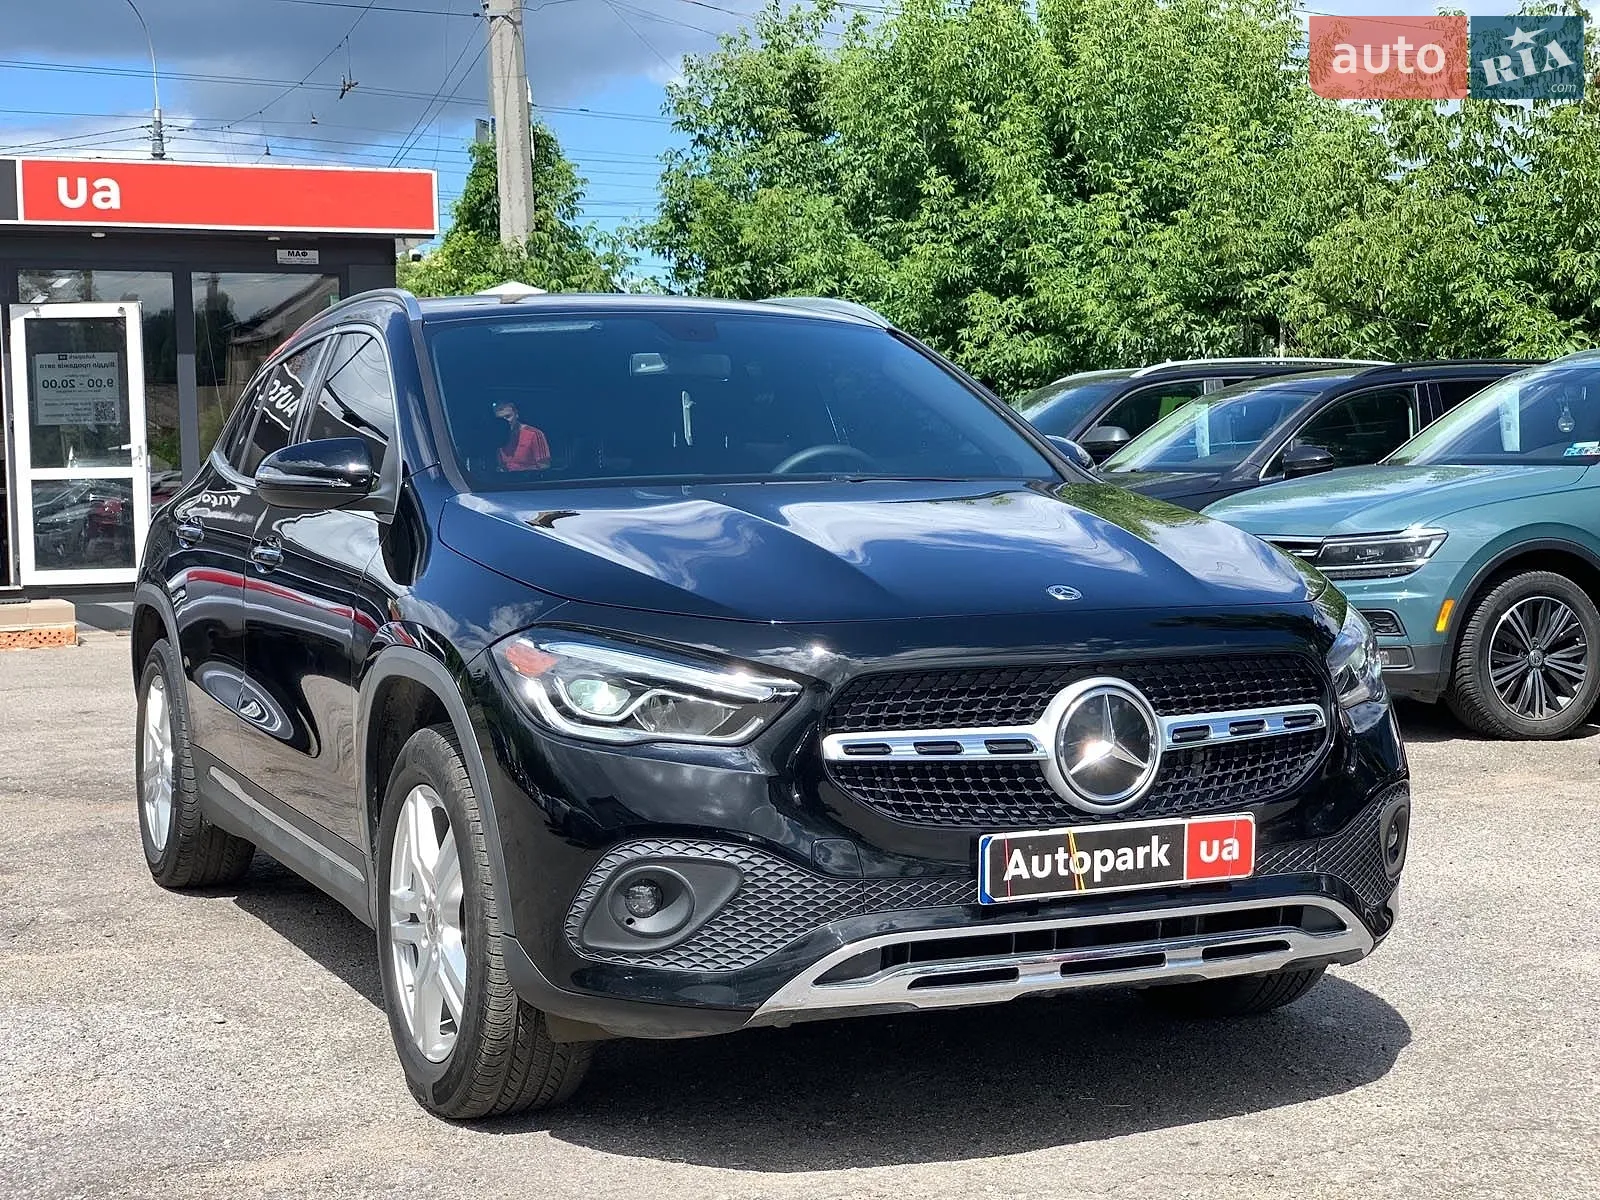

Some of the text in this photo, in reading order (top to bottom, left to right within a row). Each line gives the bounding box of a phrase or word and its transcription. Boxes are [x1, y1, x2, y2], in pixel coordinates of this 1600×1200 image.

[57, 175, 121, 210] ua
[1003, 835, 1241, 882] Autopark ua
